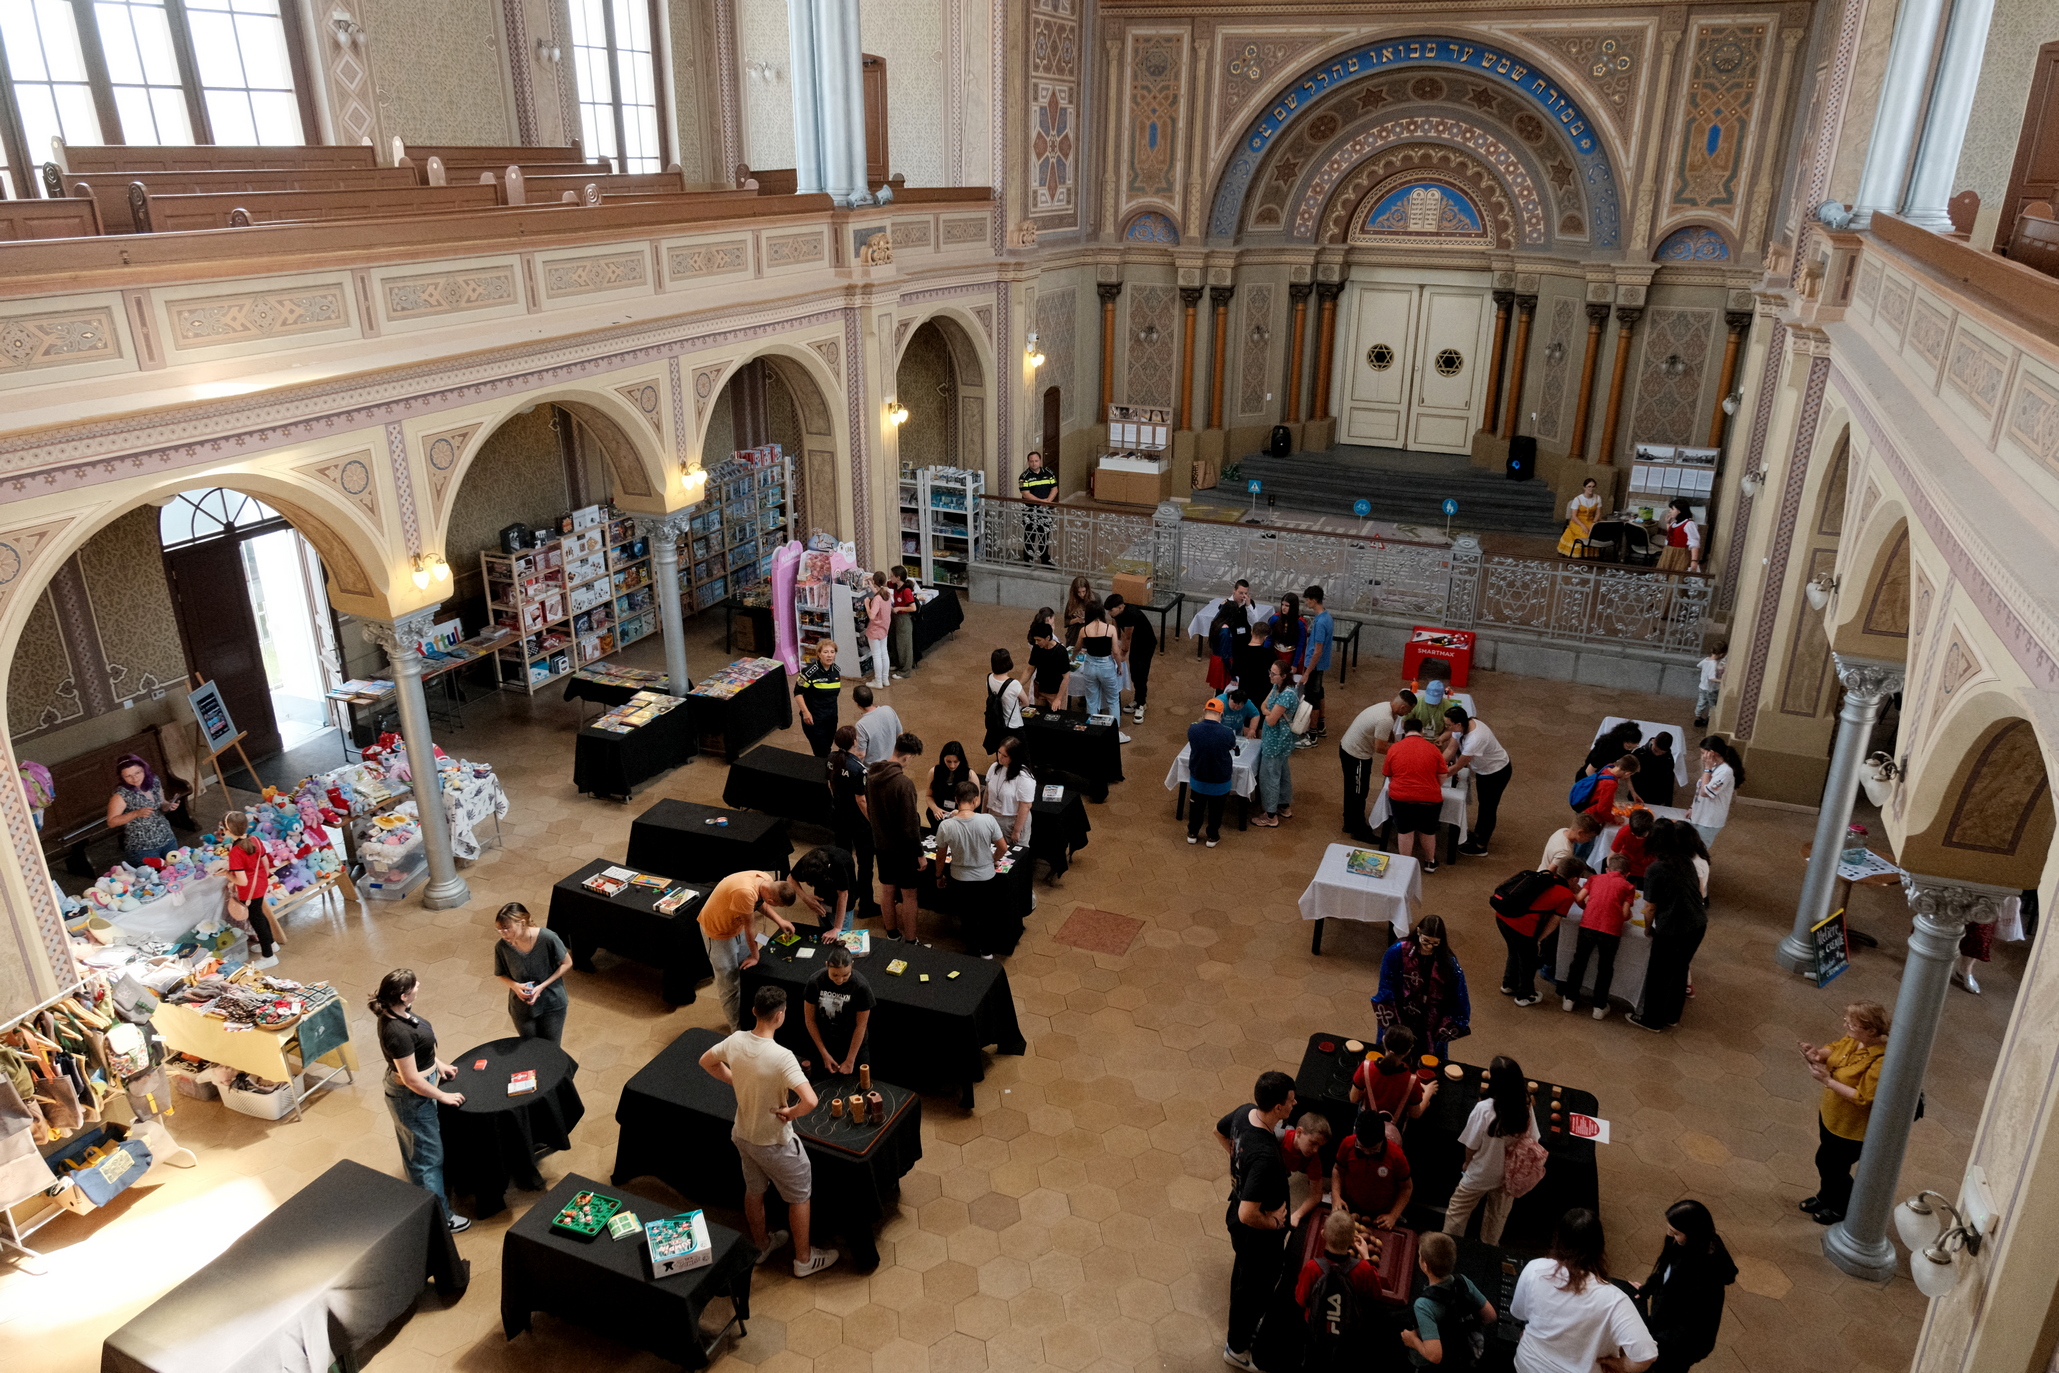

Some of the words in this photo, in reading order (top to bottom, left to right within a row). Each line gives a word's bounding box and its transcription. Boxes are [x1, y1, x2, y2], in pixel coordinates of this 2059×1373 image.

[1370, 43, 1436, 64] מבואו
[1449, 44, 1474, 62] עד
[1481, 52, 1527, 81] שמש
[1303, 58, 1359, 95] מהלל
[1273, 93, 1298, 121] שם
[1532, 79, 1585, 136] ממזרח
[1417, 647, 1455, 657] SMARTMAX
[820, 990, 851, 1001] BROOKLYN
[1326, 1293, 1342, 1335] FILA
